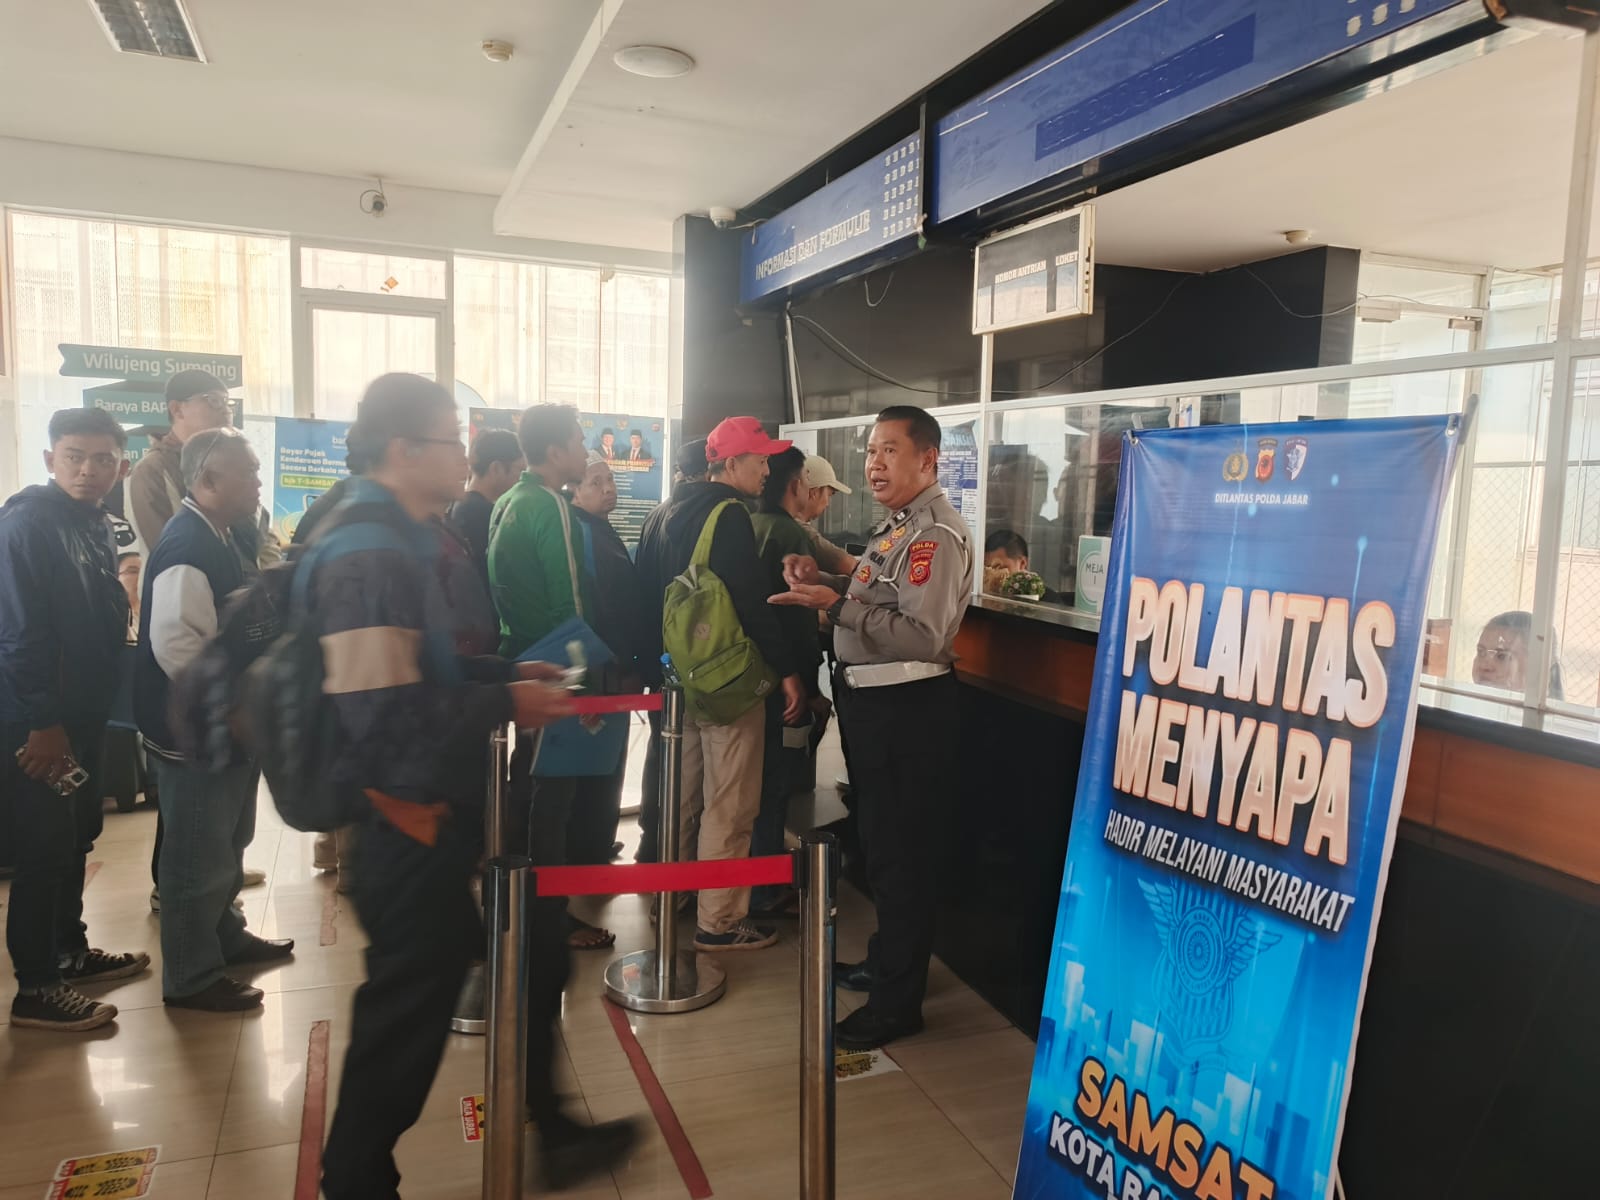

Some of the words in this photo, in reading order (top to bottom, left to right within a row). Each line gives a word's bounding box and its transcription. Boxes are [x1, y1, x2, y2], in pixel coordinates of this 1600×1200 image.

[755, 244, 796, 280] INFORMASI
[819, 209, 870, 252] FORMULIR
[1018, 260, 1046, 277] ANTRIAN
[1055, 250, 1078, 266] LOKET
[83, 352, 161, 377] Wilujeng
[95, 399, 138, 415] Baraya
[141, 401, 168, 413] BAP
[1215, 493, 1254, 505] DITLANTAS
[1255, 493, 1281, 505] POLDA
[1282, 494, 1309, 505] JABAR
[912, 542, 934, 551] POLDA
[1086, 562, 1104, 574] MEJA
[1122, 576, 1396, 728] POLANTAS
[1112, 689, 1352, 865] MENYAPA
[1104, 808, 1145, 853] HADIR
[1142, 825, 1227, 880] MELAYANI
[1223, 857, 1356, 933] MASYARAKAT
[1077, 1059, 1275, 1200] SAMSAT
[1050, 1115, 1115, 1196] KOTA
